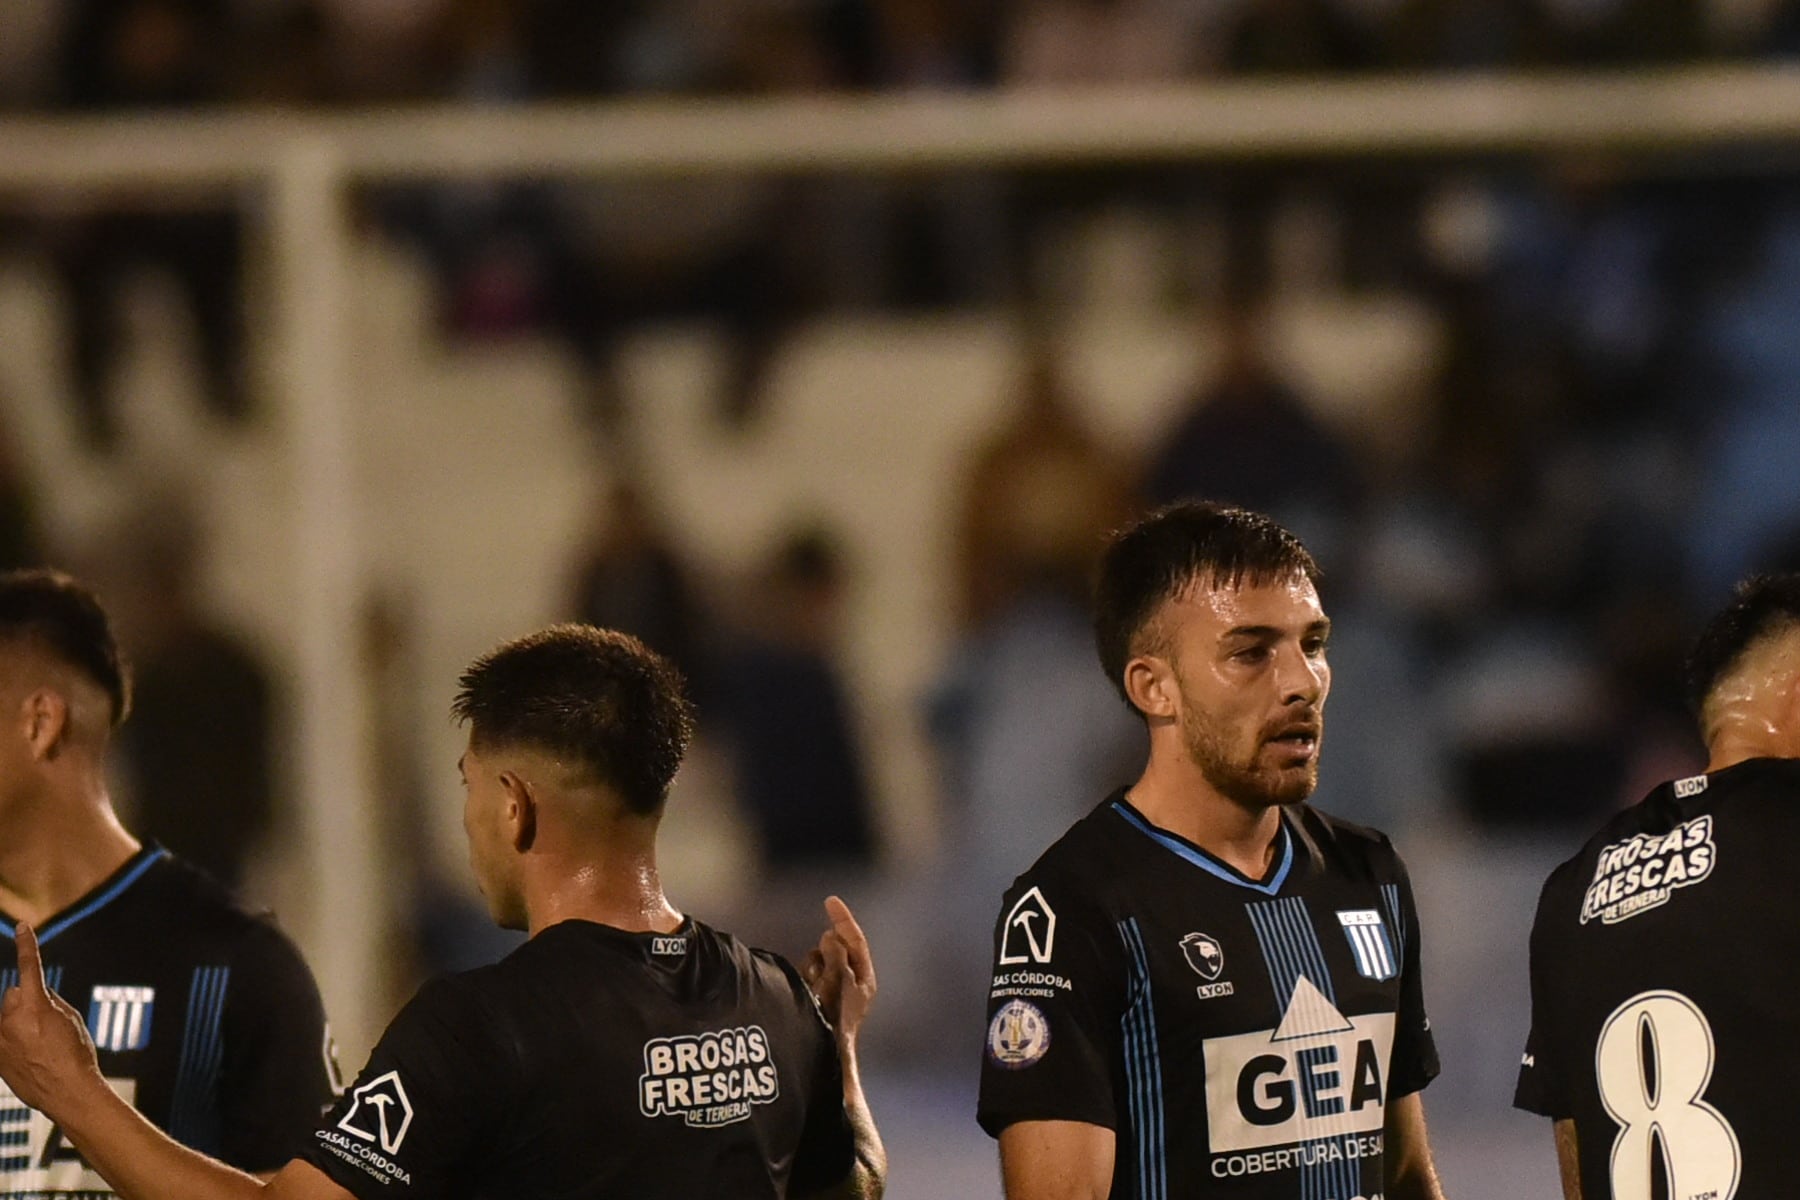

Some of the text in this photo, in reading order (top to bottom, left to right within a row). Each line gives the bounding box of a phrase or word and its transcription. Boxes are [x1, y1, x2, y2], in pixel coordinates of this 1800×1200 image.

[1584, 847, 1712, 916] FRESCAS
[1011, 970, 1072, 991] CÓRDOBA
[1199, 982, 1234, 999] LYON
[650, 1033, 766, 1076] BROSAS
[644, 1066, 776, 1110] FRESCAS
[1236, 1040, 1385, 1126] GEA
[688, 1108, 704, 1123] DE
[315, 1130, 411, 1186] CASAS CÓRDOBA
[1211, 1146, 1344, 1178] COBERTURA
[1344, 1137, 1368, 1160] DE
